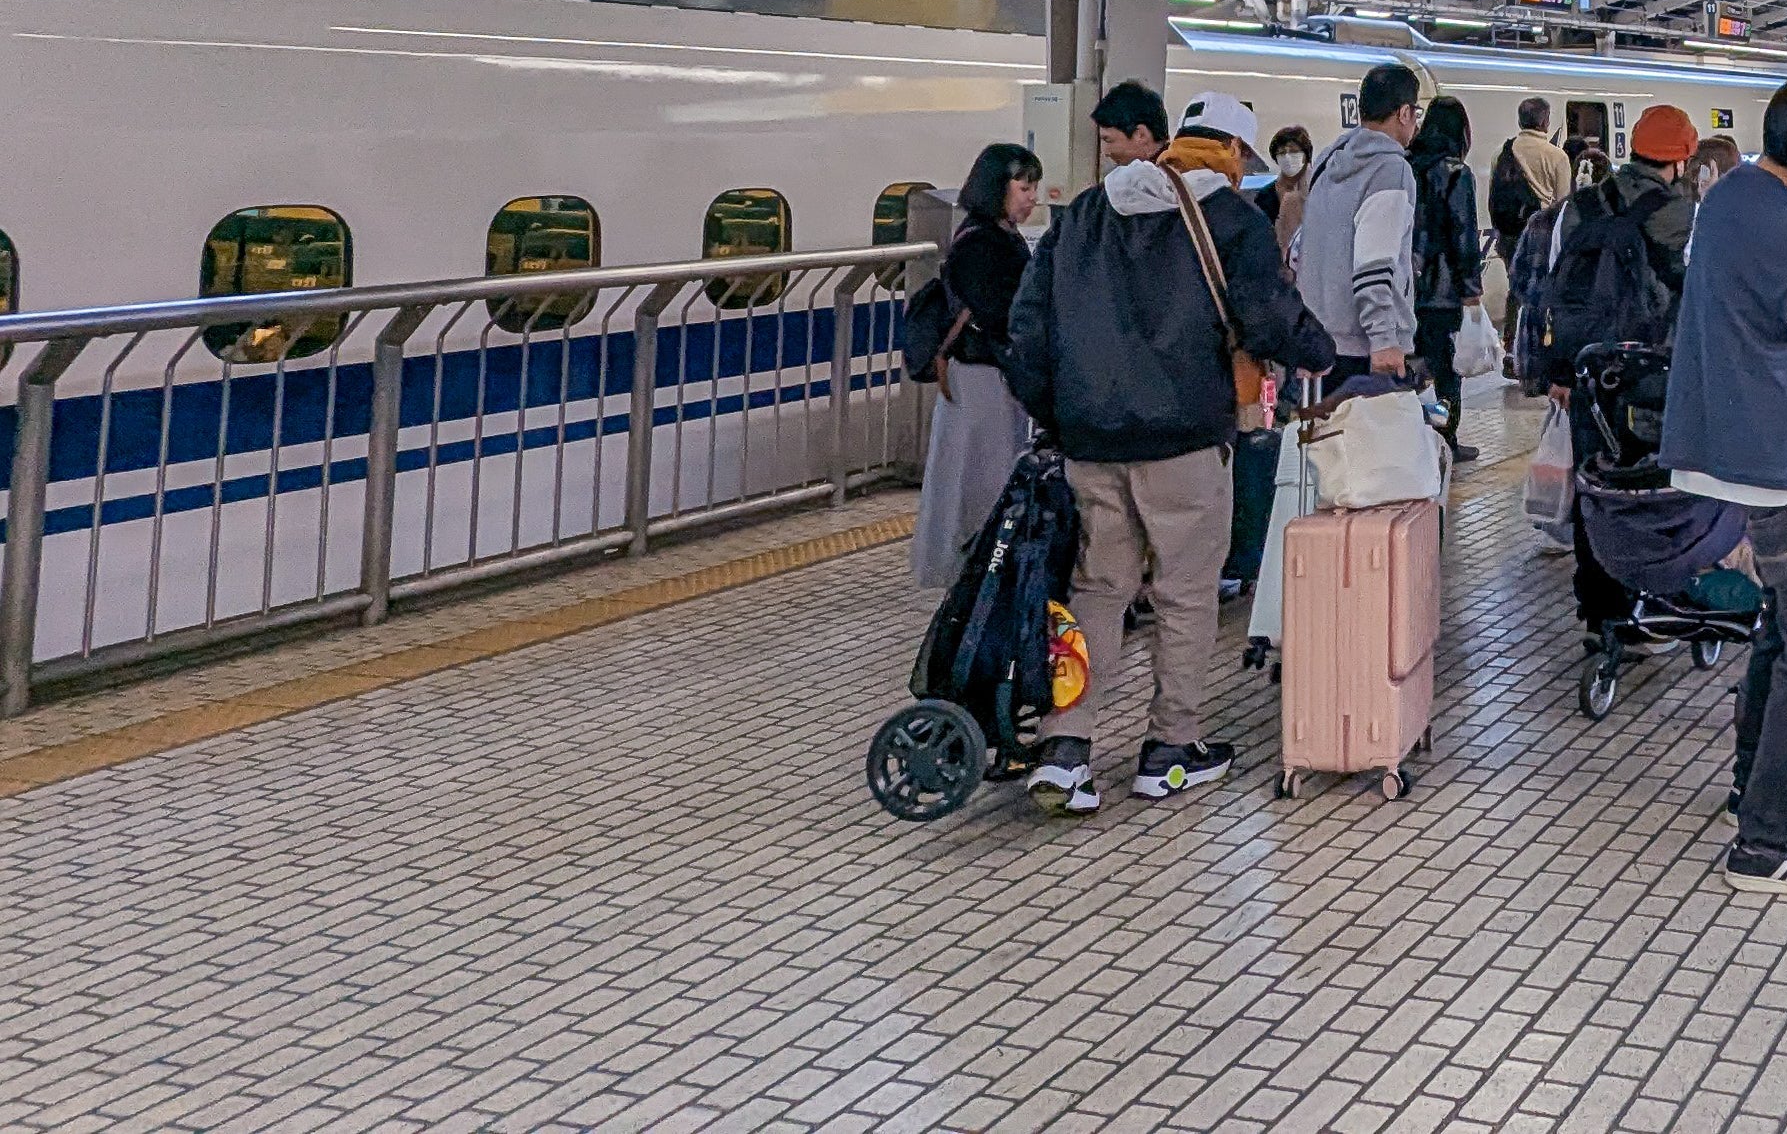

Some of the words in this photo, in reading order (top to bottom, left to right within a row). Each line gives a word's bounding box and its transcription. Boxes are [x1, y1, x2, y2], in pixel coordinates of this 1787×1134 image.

[1708, 3, 1716, 13] 11
[1341, 97, 1358, 125] 12
[1614, 105, 1624, 126] 11
